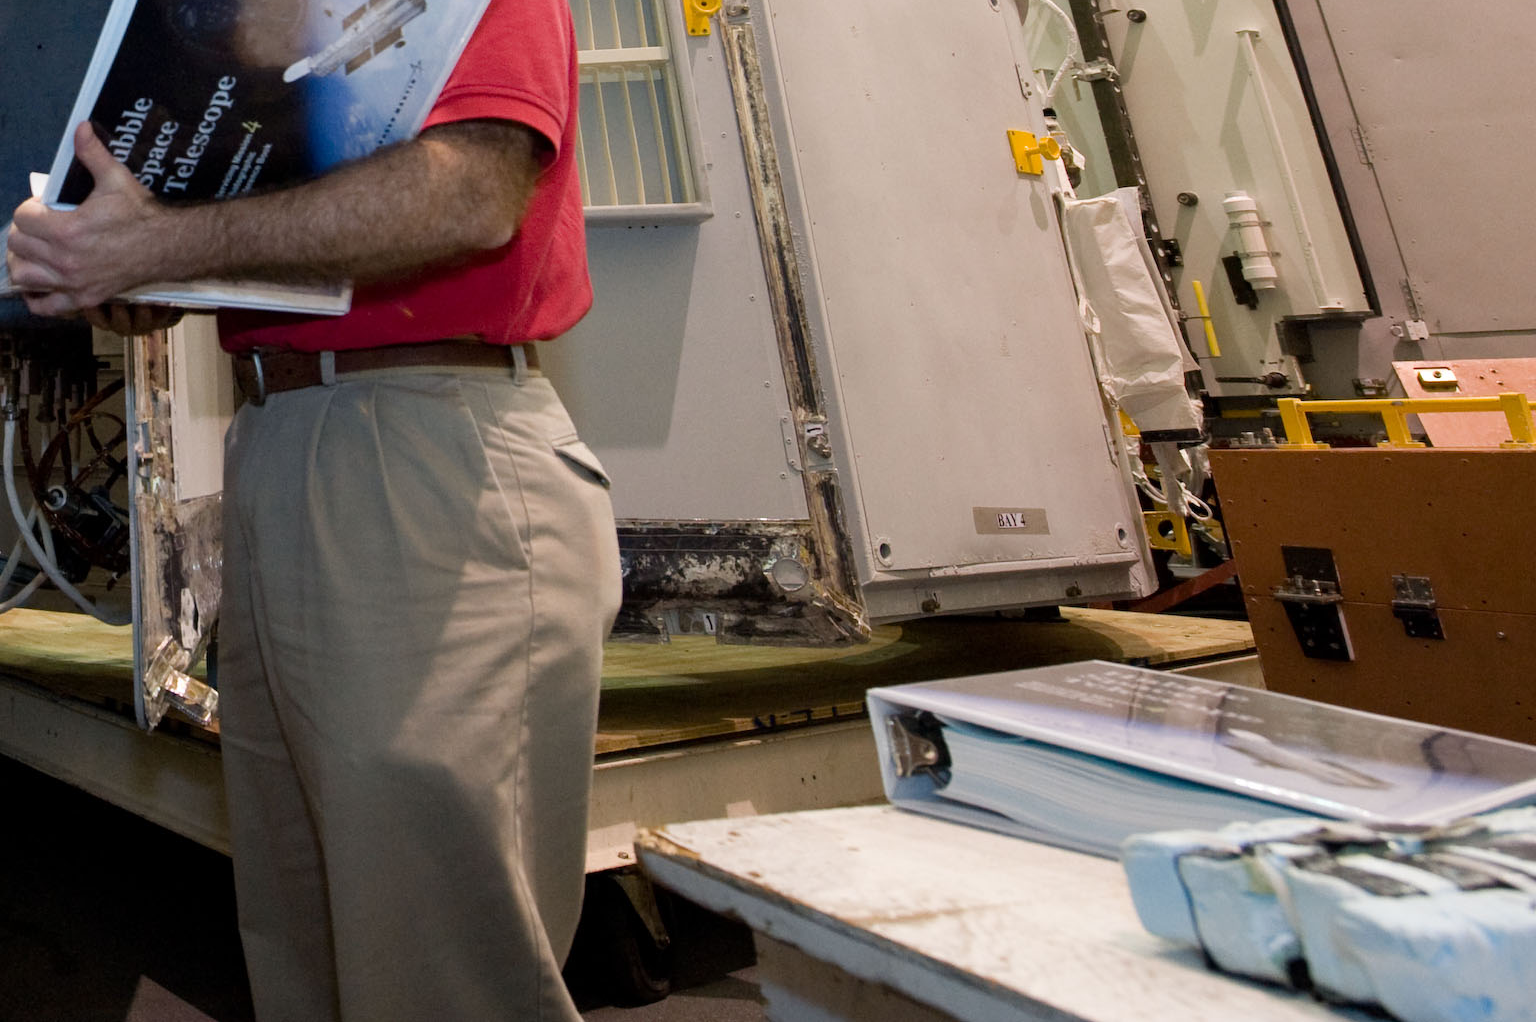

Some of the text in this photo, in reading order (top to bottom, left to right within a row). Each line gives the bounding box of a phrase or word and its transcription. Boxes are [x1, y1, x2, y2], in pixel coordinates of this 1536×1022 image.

[109, 97, 153, 163] ubble
[163, 75, 237, 193] Telescope
[242, 121, 263, 134] 4
[997, 513, 1026, 527] BAY 4
